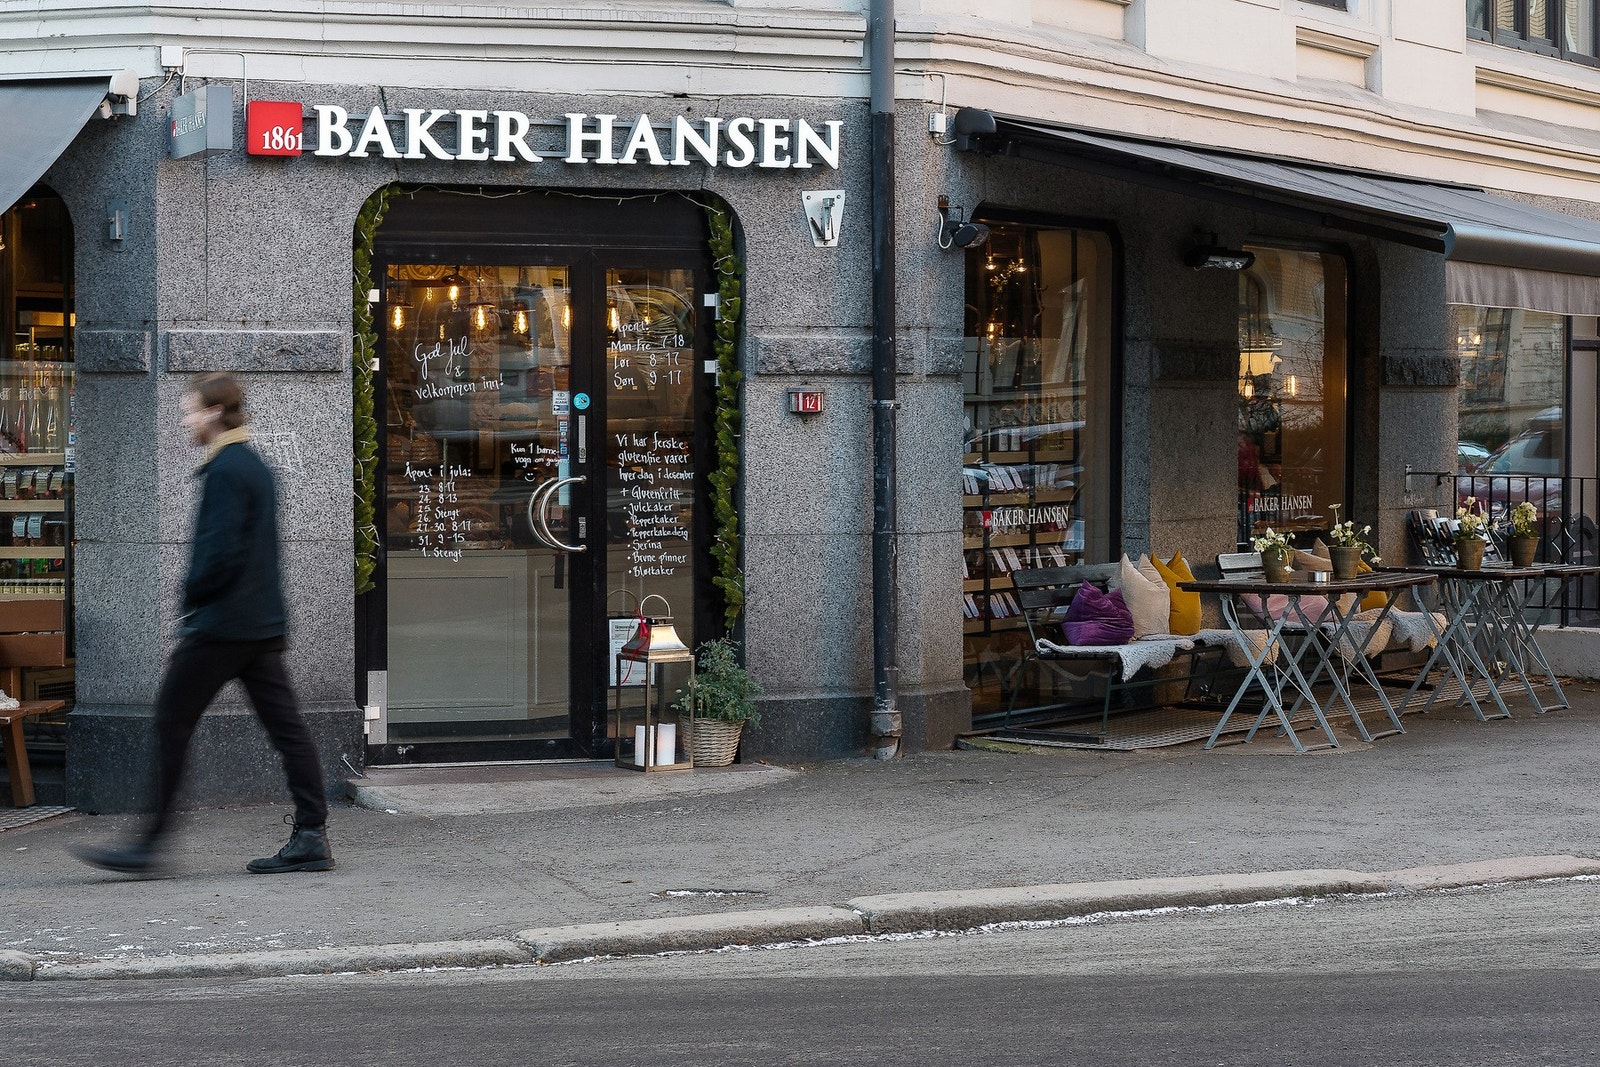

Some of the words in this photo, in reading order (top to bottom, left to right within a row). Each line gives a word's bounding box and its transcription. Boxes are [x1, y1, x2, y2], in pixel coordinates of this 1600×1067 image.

[262, 125, 303, 151] 1861
[314, 105, 543, 163] BAKER
[565, 112, 844, 169] HANSEN
[614, 356, 630, 370] Lør
[415, 381, 476, 400] velkommen
[482, 373, 504, 390] inn!
[614, 372, 635, 387] Søn
[805, 396, 816, 409] 12
[615, 434, 628, 447] Vi
[633, 433, 648, 447] har
[510, 443, 526, 454] Kun
[528, 443, 534, 454] 1
[515, 456, 532, 468] vogn
[664, 454, 690, 464] varer
[404, 461, 432, 481] Åpent
[440, 465, 444, 477] i
[658, 467, 662, 479] i
[628, 502, 674, 516] Julekaker
[1254, 496, 1280, 512] BAKER
[1281, 494, 1313, 511] HANSEN
[435, 506, 460, 521] Stengt
[631, 514, 679, 527] Pepperkaker
[993, 510, 1025, 527] BAKER
[1028, 506, 1070, 525] HANSEN
[632, 539, 662, 551] Serina
[433, 547, 462, 562] Stengt
[632, 551, 657, 563] Brune
[658, 552, 687, 564] pinner
